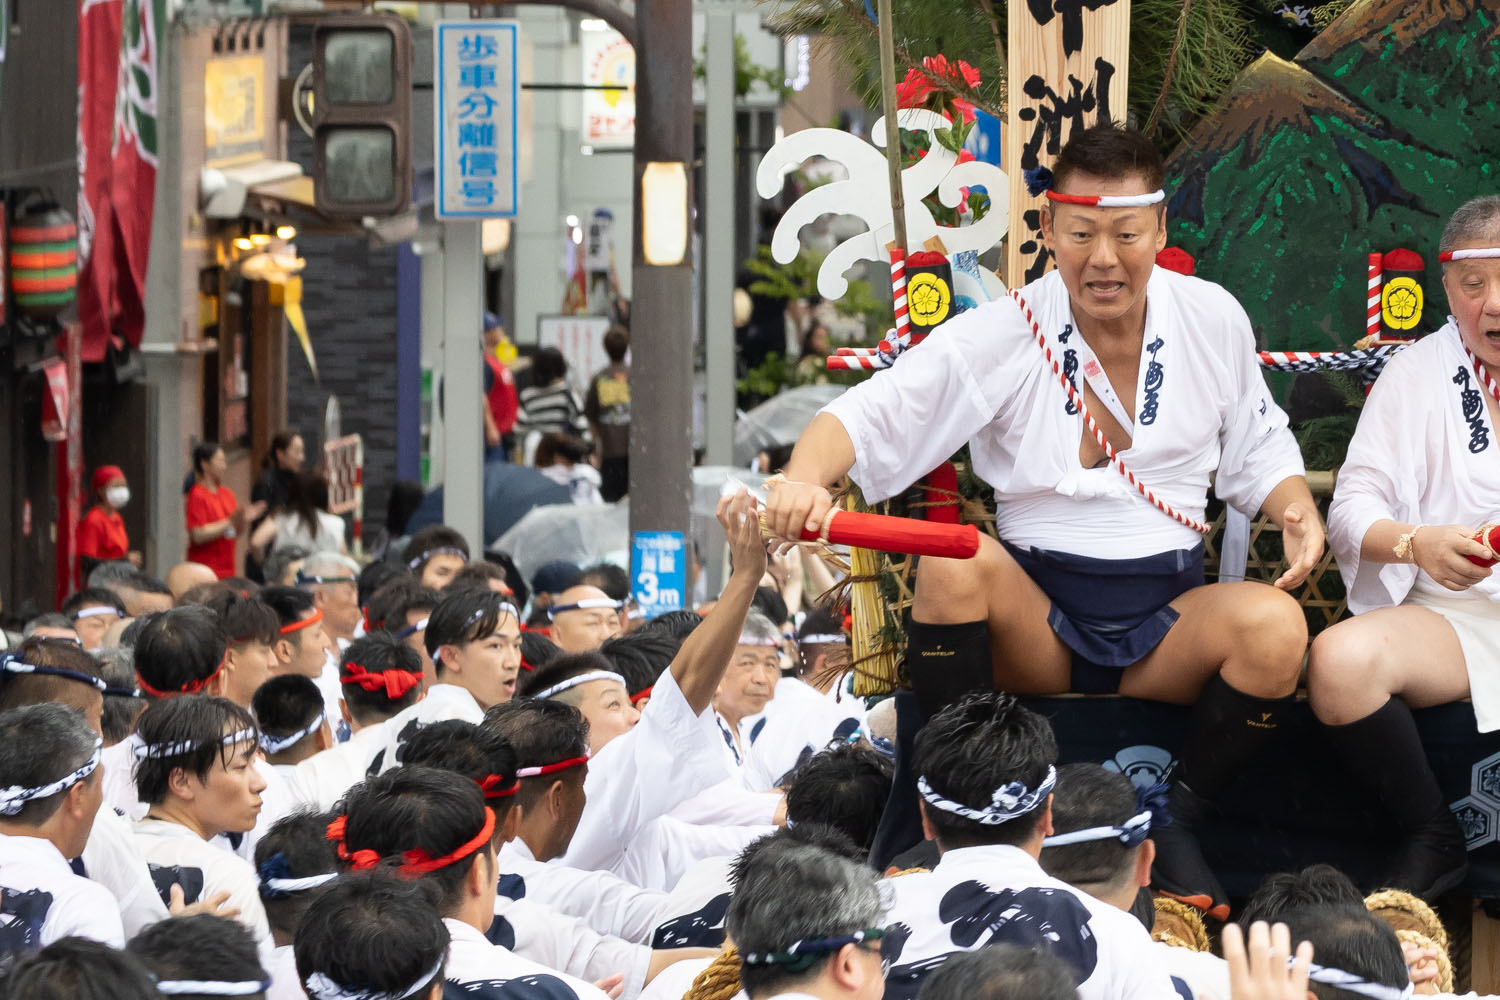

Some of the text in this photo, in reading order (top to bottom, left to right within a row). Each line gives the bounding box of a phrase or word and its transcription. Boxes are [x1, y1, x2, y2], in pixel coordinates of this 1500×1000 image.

[458, 35, 499, 208] 歩車分離信号
[636, 571, 680, 606] 3m
